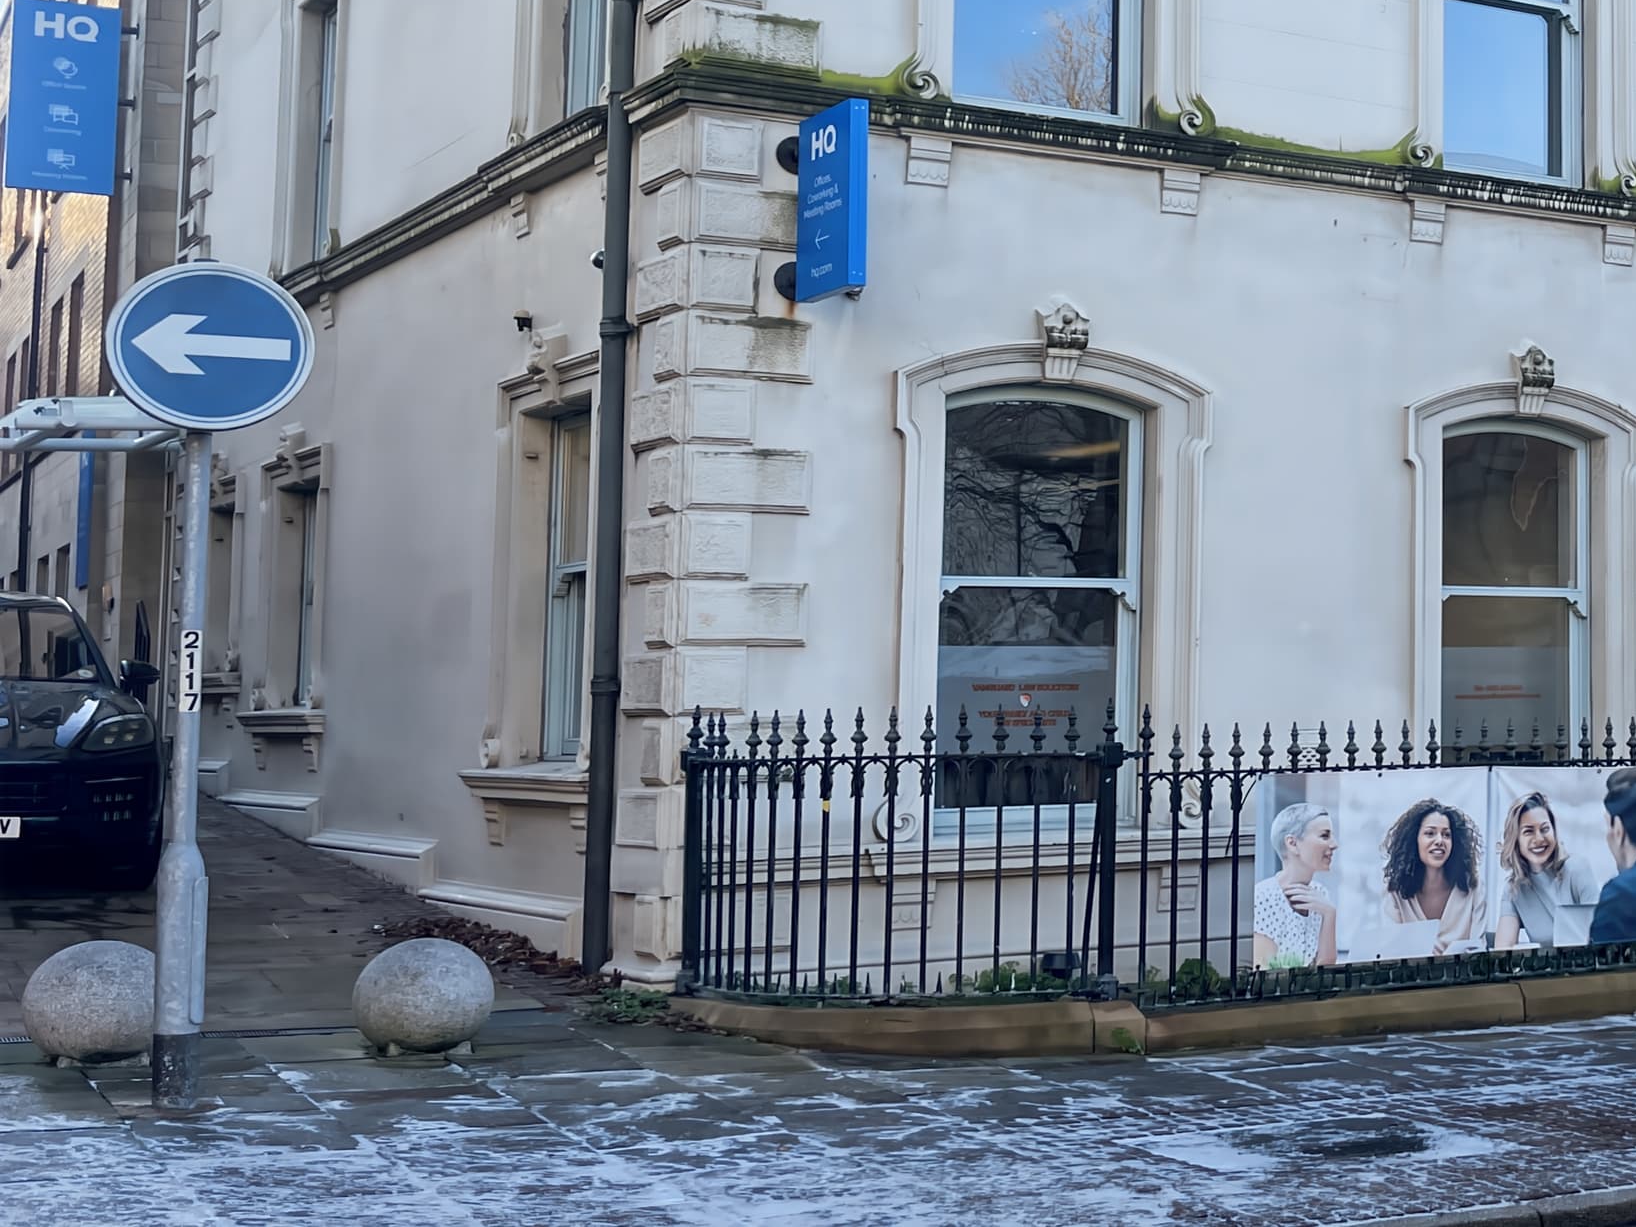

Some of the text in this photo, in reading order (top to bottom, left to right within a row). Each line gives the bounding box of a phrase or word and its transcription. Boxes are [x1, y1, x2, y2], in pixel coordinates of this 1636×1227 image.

[34, 10, 99, 43] HQ
[811, 124, 837, 161] HQ
[183, 630, 200, 712] 2117
